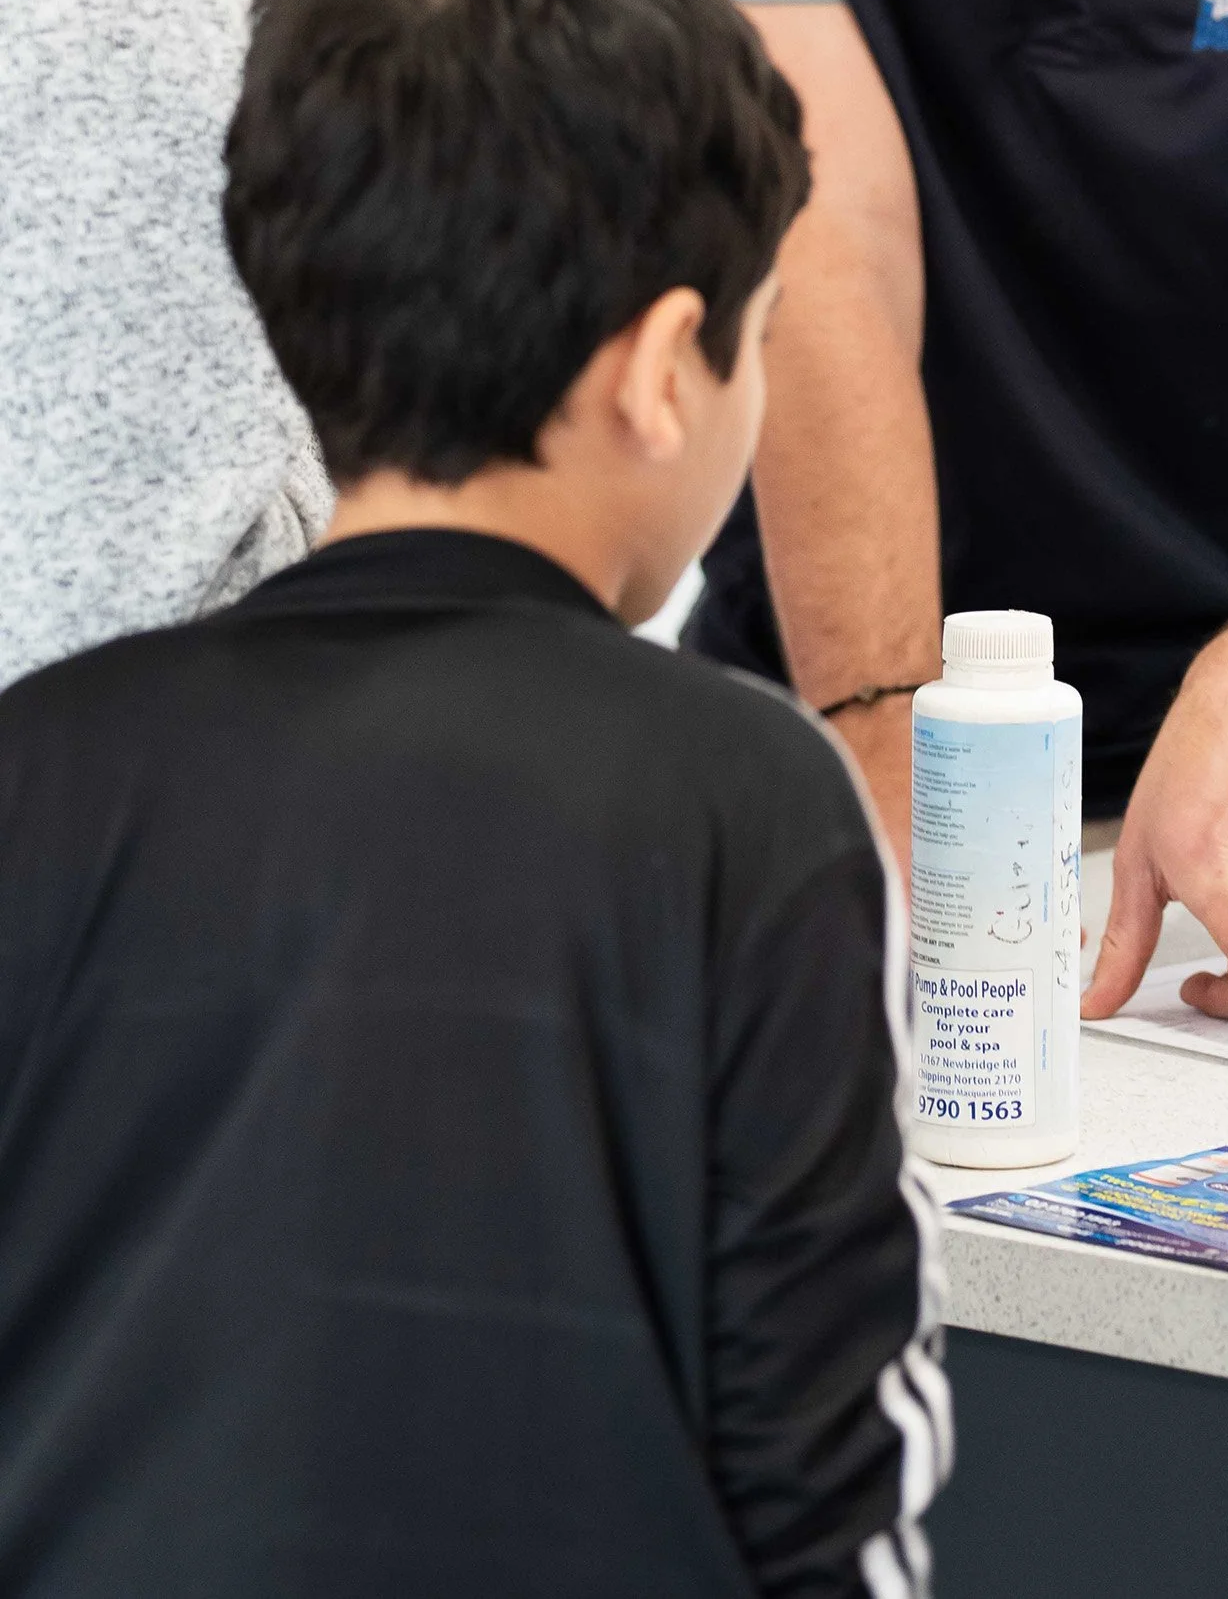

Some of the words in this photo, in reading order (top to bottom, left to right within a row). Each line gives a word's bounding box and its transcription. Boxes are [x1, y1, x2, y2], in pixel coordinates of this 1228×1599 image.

[915, 972, 938, 999] Pump
[940, 978, 948, 997] &
[951, 979, 978, 999] Pool
[981, 978, 1026, 1003] People
[921, 1001, 979, 1019] Complete
[983, 1008, 1014, 1018] care
[936, 1019, 954, 1032] for
[957, 1024, 990, 1036] your
[930, 1038, 957, 1050] pool
[960, 1039, 971, 1051] &
[975, 1042, 1001, 1054] spa
[942, 1057, 1000, 1072] Newbridge
[1003, 1058, 1018, 1070] Rd
[954, 1074, 992, 1085] Norton
[995, 1074, 1022, 1085] 2170
[956, 1088, 996, 1098] Macquarie
[919, 1095, 960, 1119] 9790
[967, 1100, 1023, 1120] 1563
